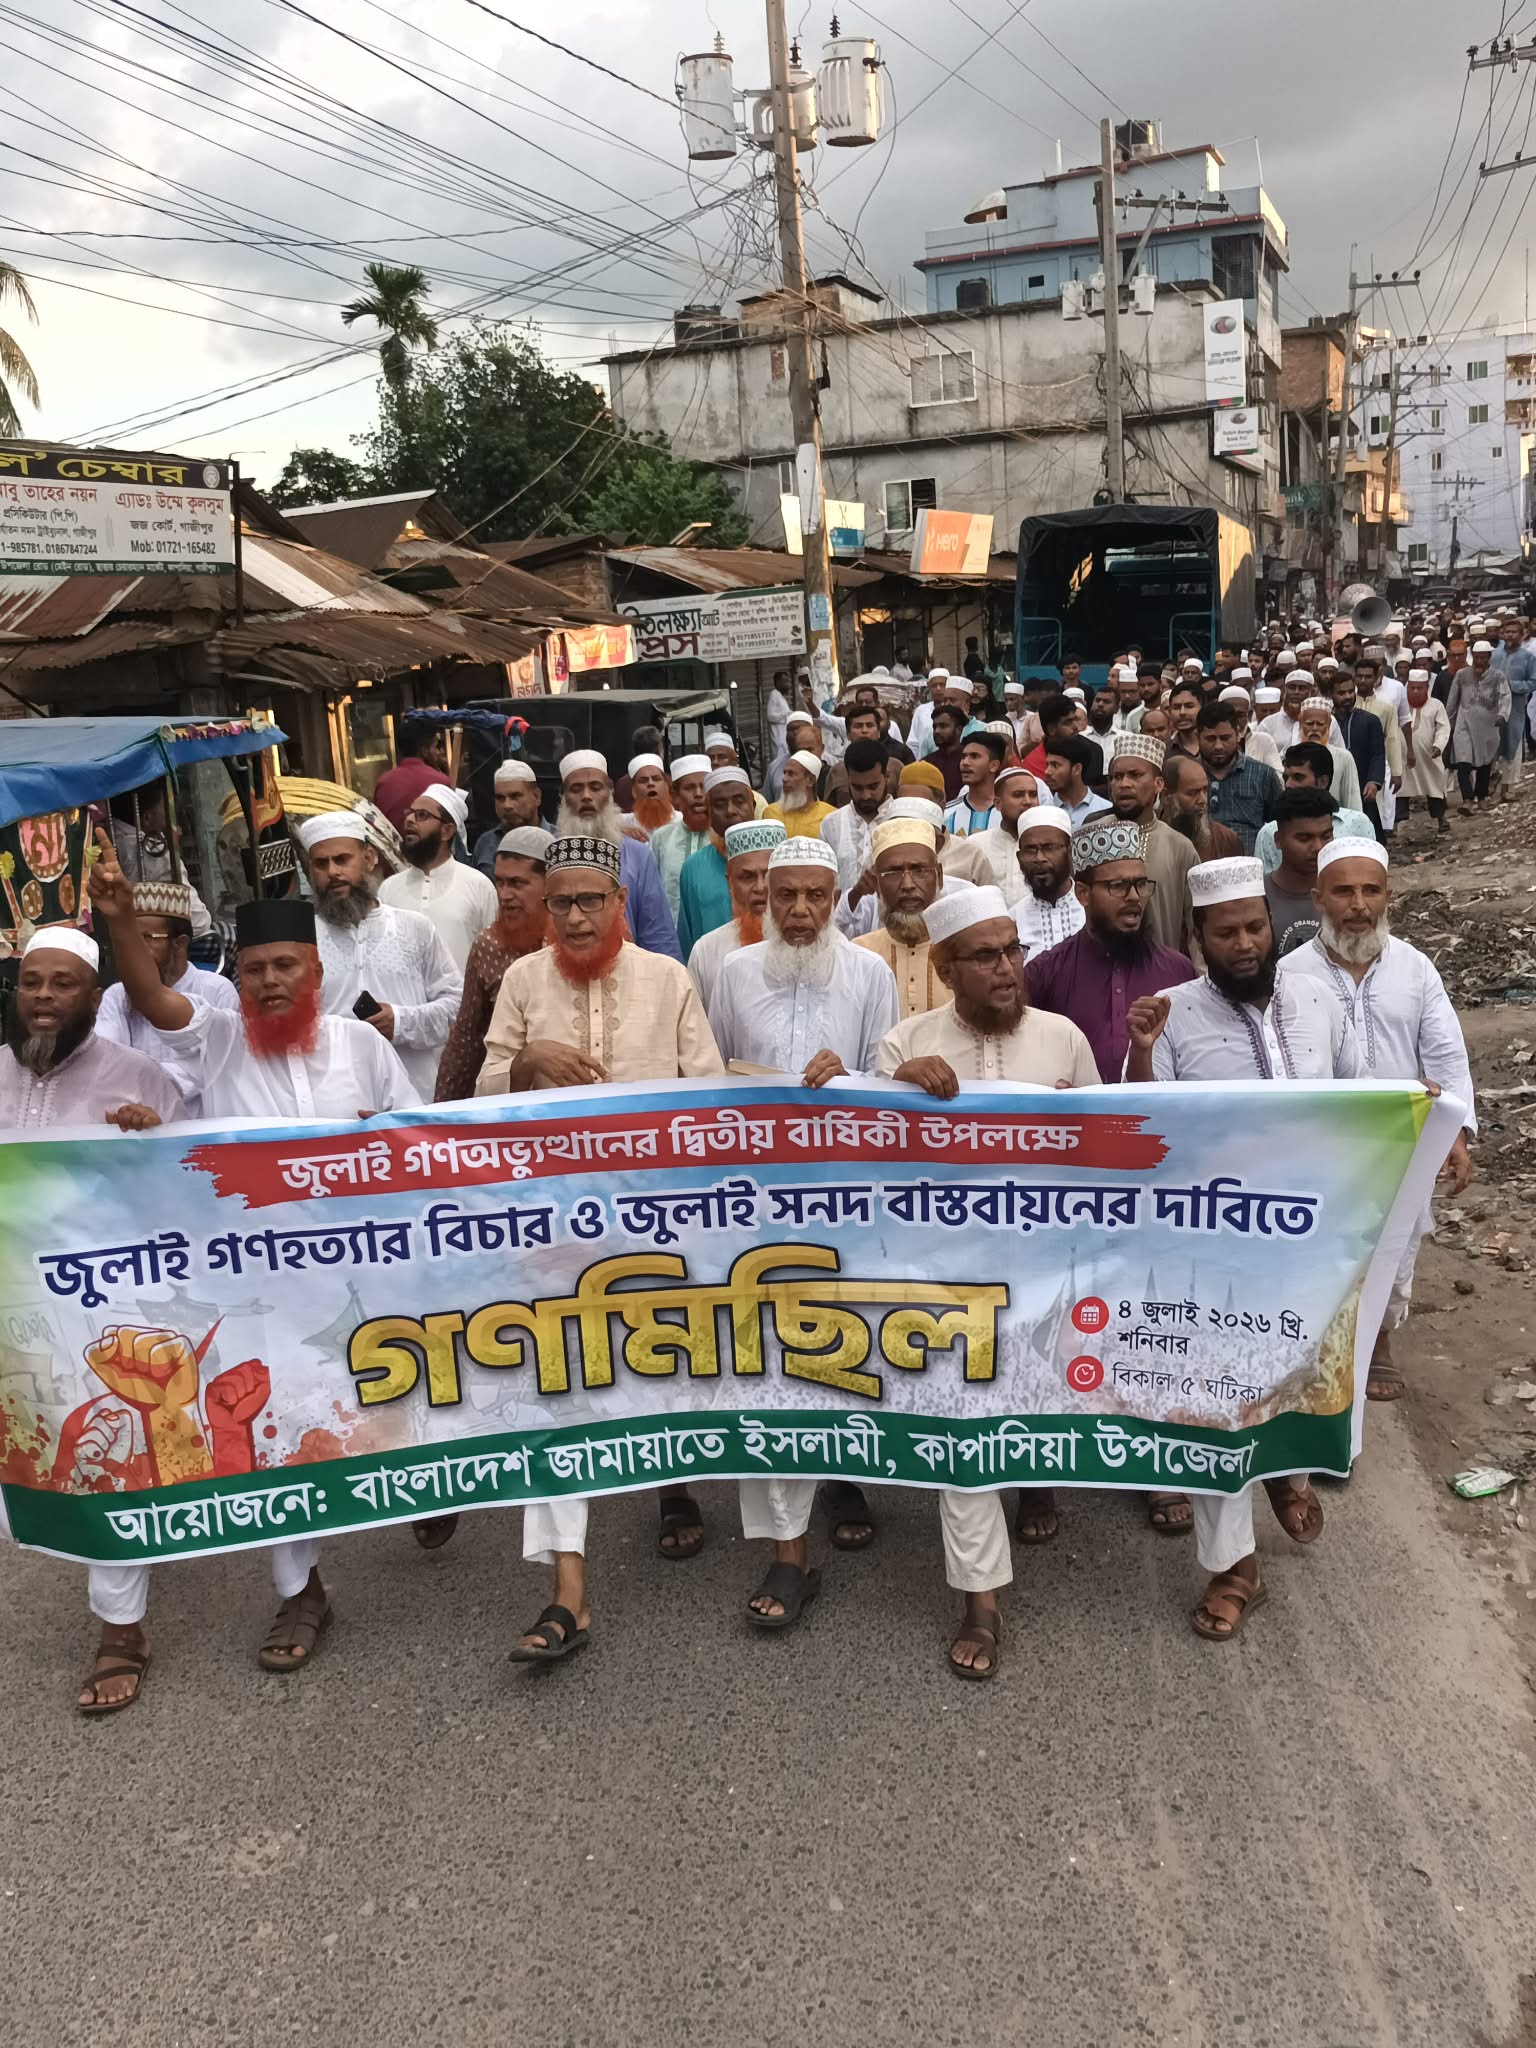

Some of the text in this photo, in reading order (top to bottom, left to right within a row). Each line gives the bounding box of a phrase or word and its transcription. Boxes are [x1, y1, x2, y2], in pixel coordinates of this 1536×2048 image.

[22, 484, 65, 503] তাহের
[68, 487, 98, 503] নয়ন
[57, 458, 190, 485] চেম্বার
[1284, 490, 1305, 503] ank
[131, 540, 217, 555] Mob: 01721-165482
[277, 1109, 1083, 1198] জুলাই গণঅভ্যুত্থানের দ্বিতীয় বার্ষিকী উপলক্ষে
[38, 1177, 1318, 1308] জুলাই গণহত্যার বিচার ও জুলাই সনদ বাস্তবায়নের দাবিতে
[346, 1242, 1010, 1408] গণমিছিল
[1117, 1325, 1191, 1356] শনিবার
[1118, 1298, 1309, 1342] ৪ জুলাই ২০২৬ খ্রি.
[1111, 1361, 1264, 1405] বিকাল ৫ ঘটিকা
[103, 1413, 1259, 1547] আয়োজনে: বাংলাদেশ জামায়াতে ইসলামী, কাপাসিয়া উপজেলা
